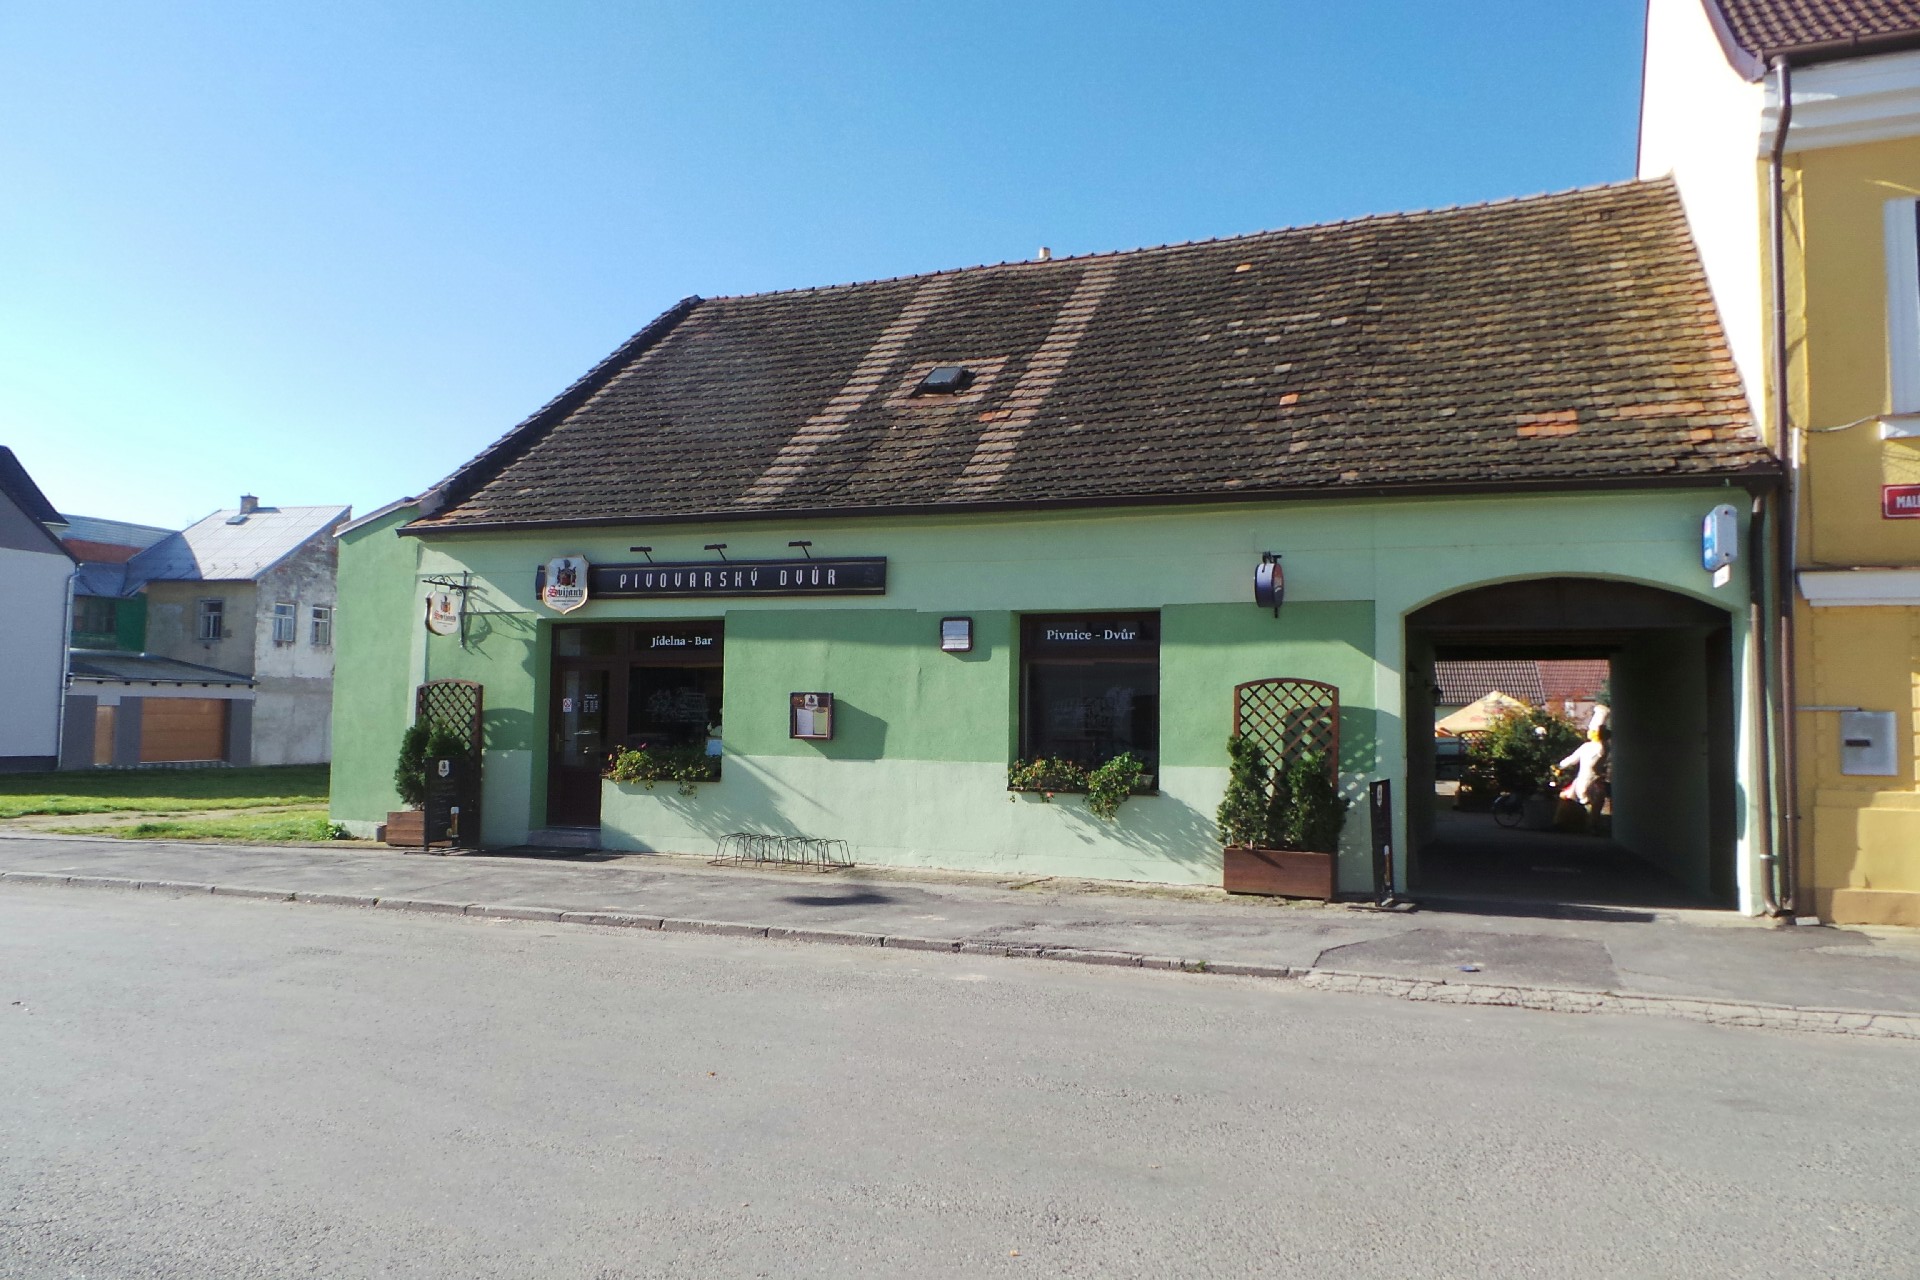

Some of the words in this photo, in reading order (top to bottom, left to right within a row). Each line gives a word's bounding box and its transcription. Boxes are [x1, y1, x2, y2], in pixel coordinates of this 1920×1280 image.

[620, 568, 758, 588] PIVOVARSKÝ
[780, 566, 836, 586] DVŮR
[547, 585, 583, 598] Svijany
[1046, 629, 1092, 640] Pivnice
[1104, 628, 1136, 640] Dvůr
[650, 635, 686, 648] Jídelna
[694, 636, 713, 646] Bar
